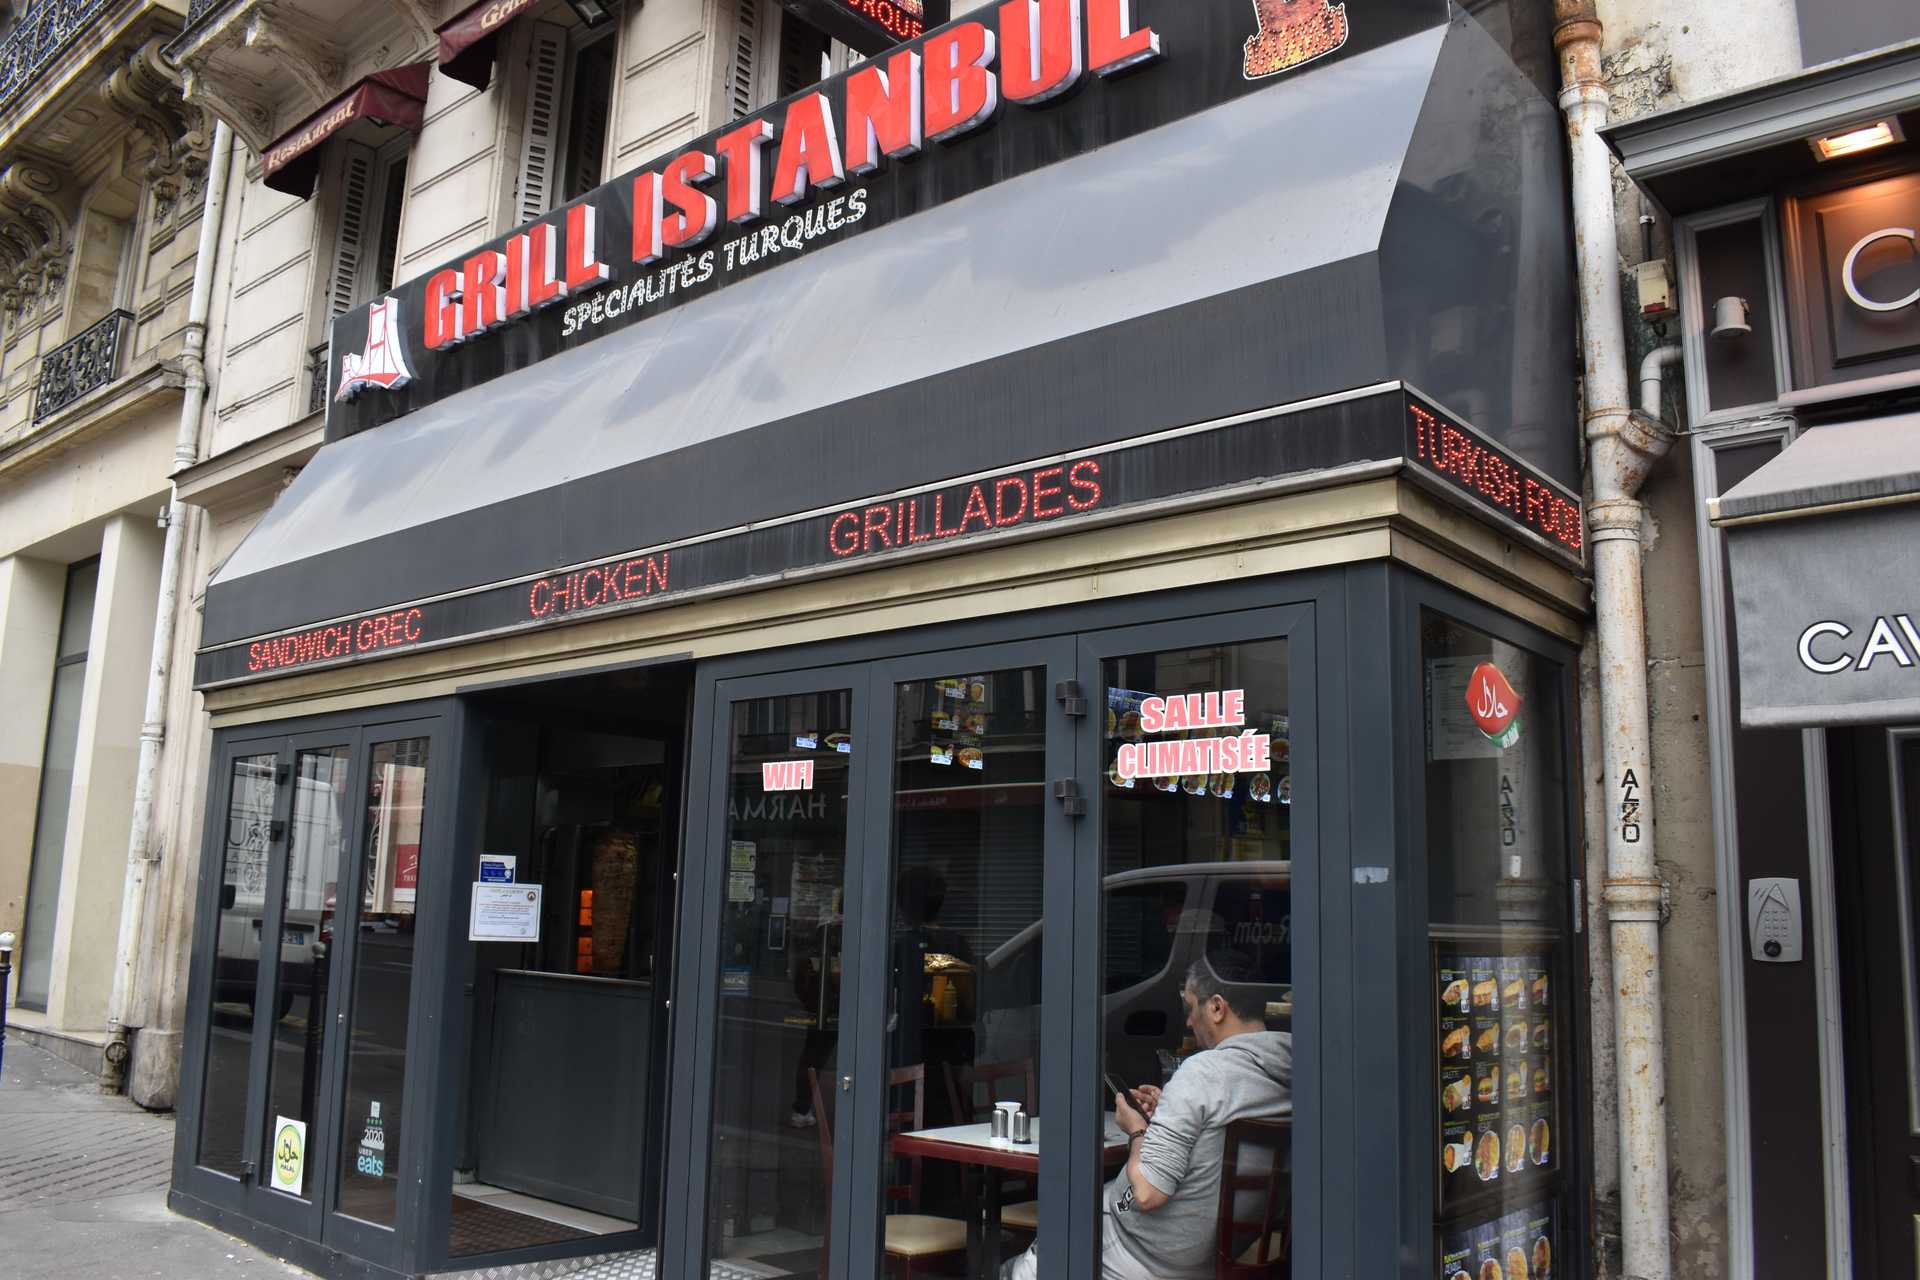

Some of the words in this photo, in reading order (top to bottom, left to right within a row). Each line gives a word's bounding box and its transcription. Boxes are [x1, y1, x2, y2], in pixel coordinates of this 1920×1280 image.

[268, 101, 354, 170] Restaurant
[424, 203, 609, 350] GRILL
[632, 0, 1160, 264] ISTANBUL
[724, 188, 867, 271] TURQUES
[1409, 404, 1521, 513] TURKISH
[1526, 478, 1581, 548] FOOD
[829, 460, 1101, 557] GRILLADES
[529, 558, 669, 618] CHICKEN
[249, 623, 351, 672] SANDWICH
[356, 607, 422, 651] GREC
[1140, 689, 1245, 733] SALLE
[762, 760, 814, 791] WIFI
[1117, 729, 1271, 779] CLIMATISÉE
[357, 1155, 383, 1177] eats
[364, 1129, 384, 1144] 2020
